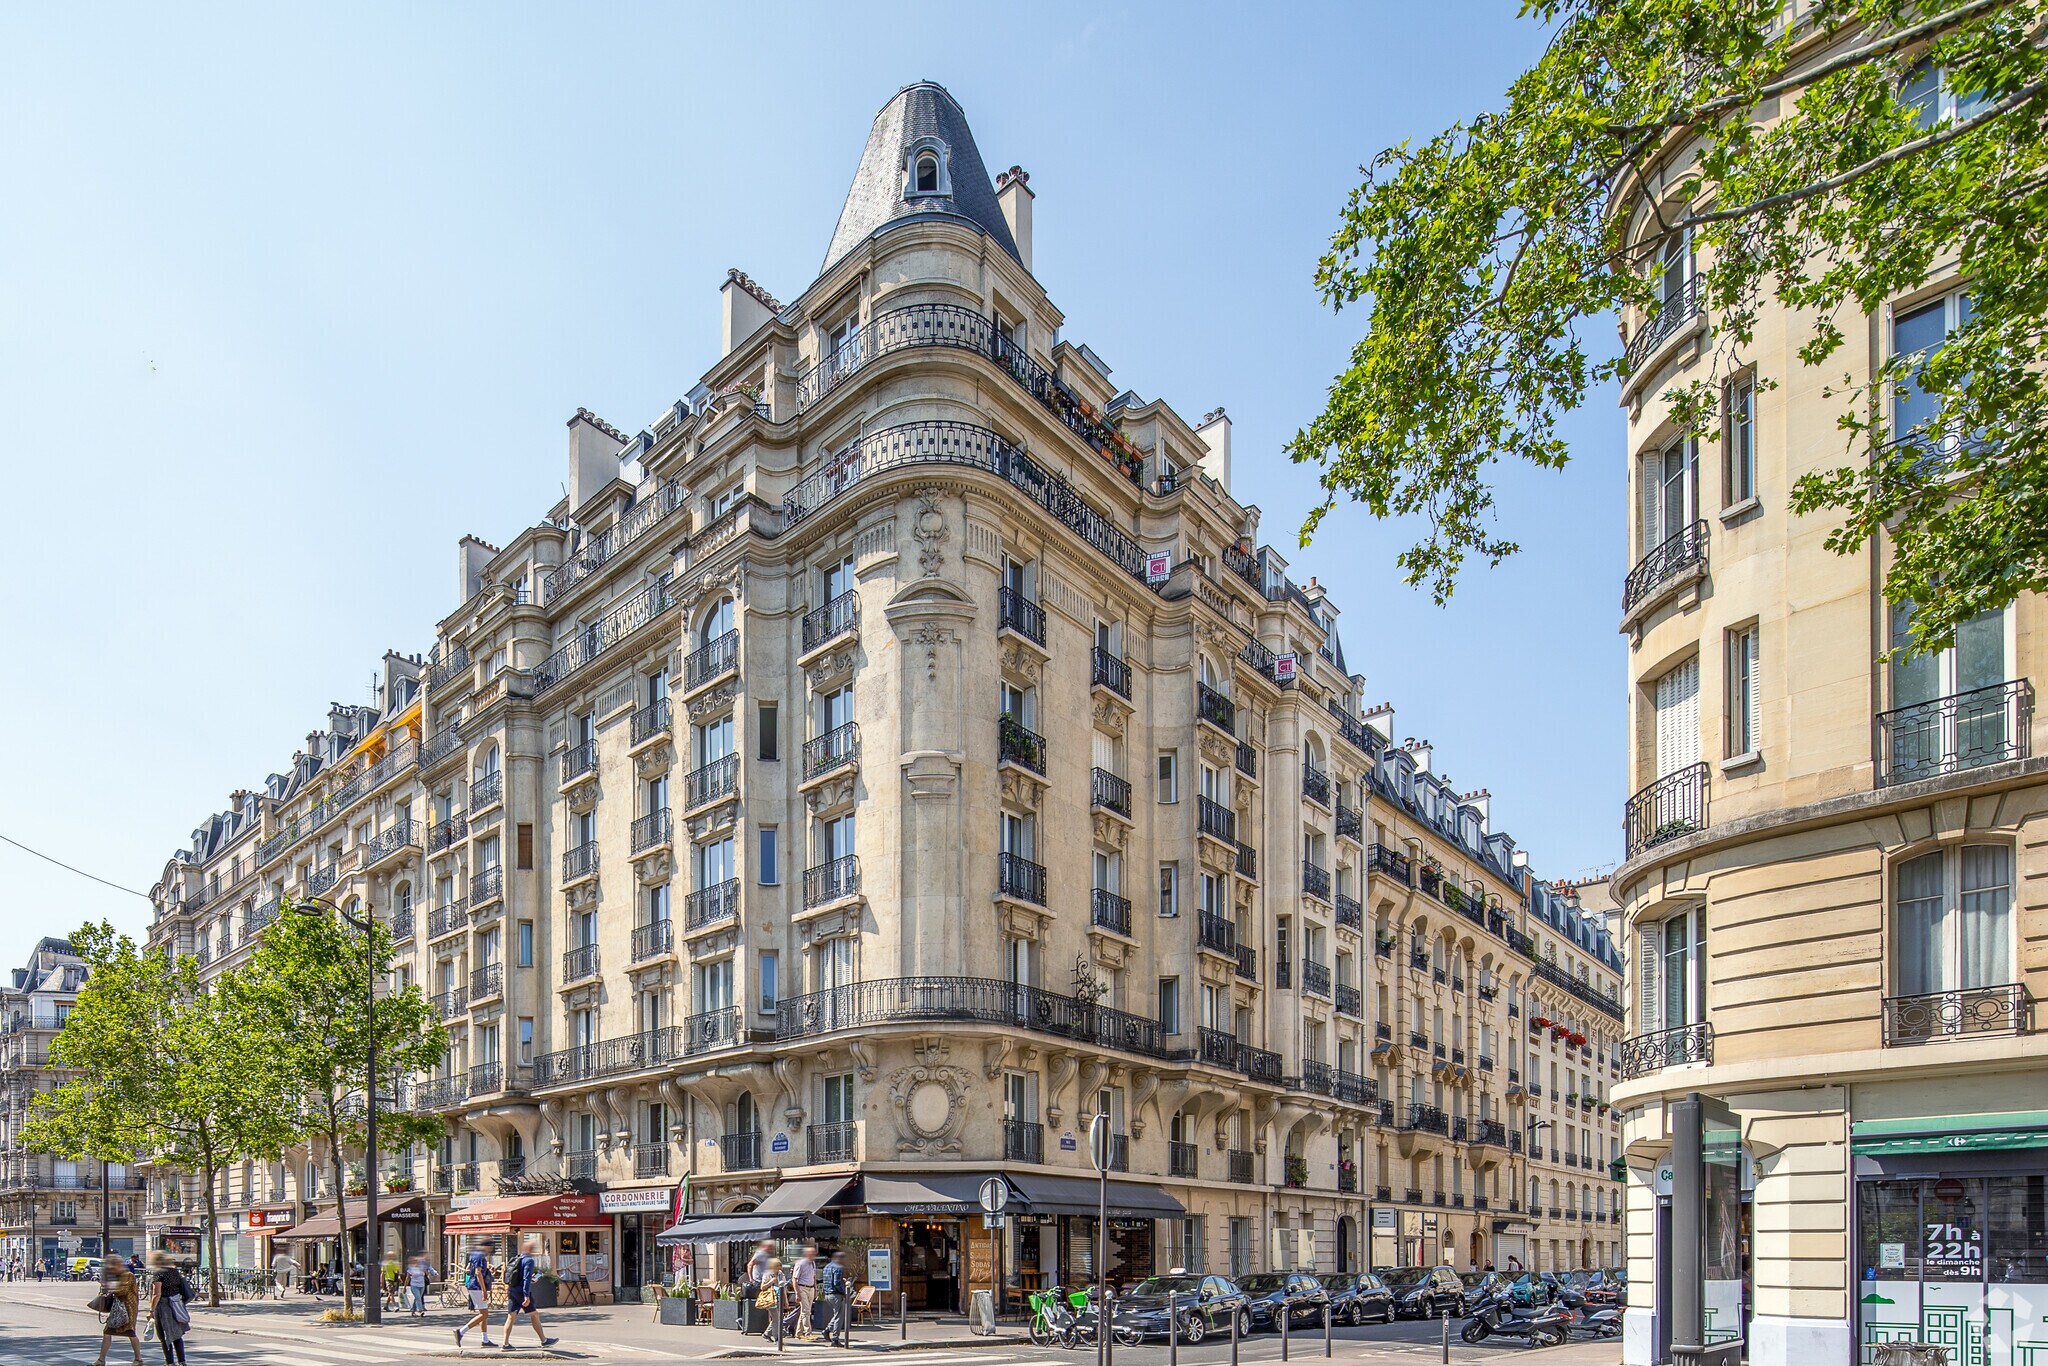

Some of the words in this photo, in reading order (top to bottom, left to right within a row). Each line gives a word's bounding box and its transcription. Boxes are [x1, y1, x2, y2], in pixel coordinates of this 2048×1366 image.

[1151, 550, 1169, 559] VENDRE
[605, 1191, 664, 1202] CORDONNERIE
[904, 1203, 925, 1212] CHEZ
[926, 1203, 969, 1212] VALENTINO
[1927, 1223, 1962, 1241] 7h
[1971, 1230, 1981, 1241] à
[1926, 1242, 1980, 1259] 22h
[1960, 1266, 1981, 1276] 9h
